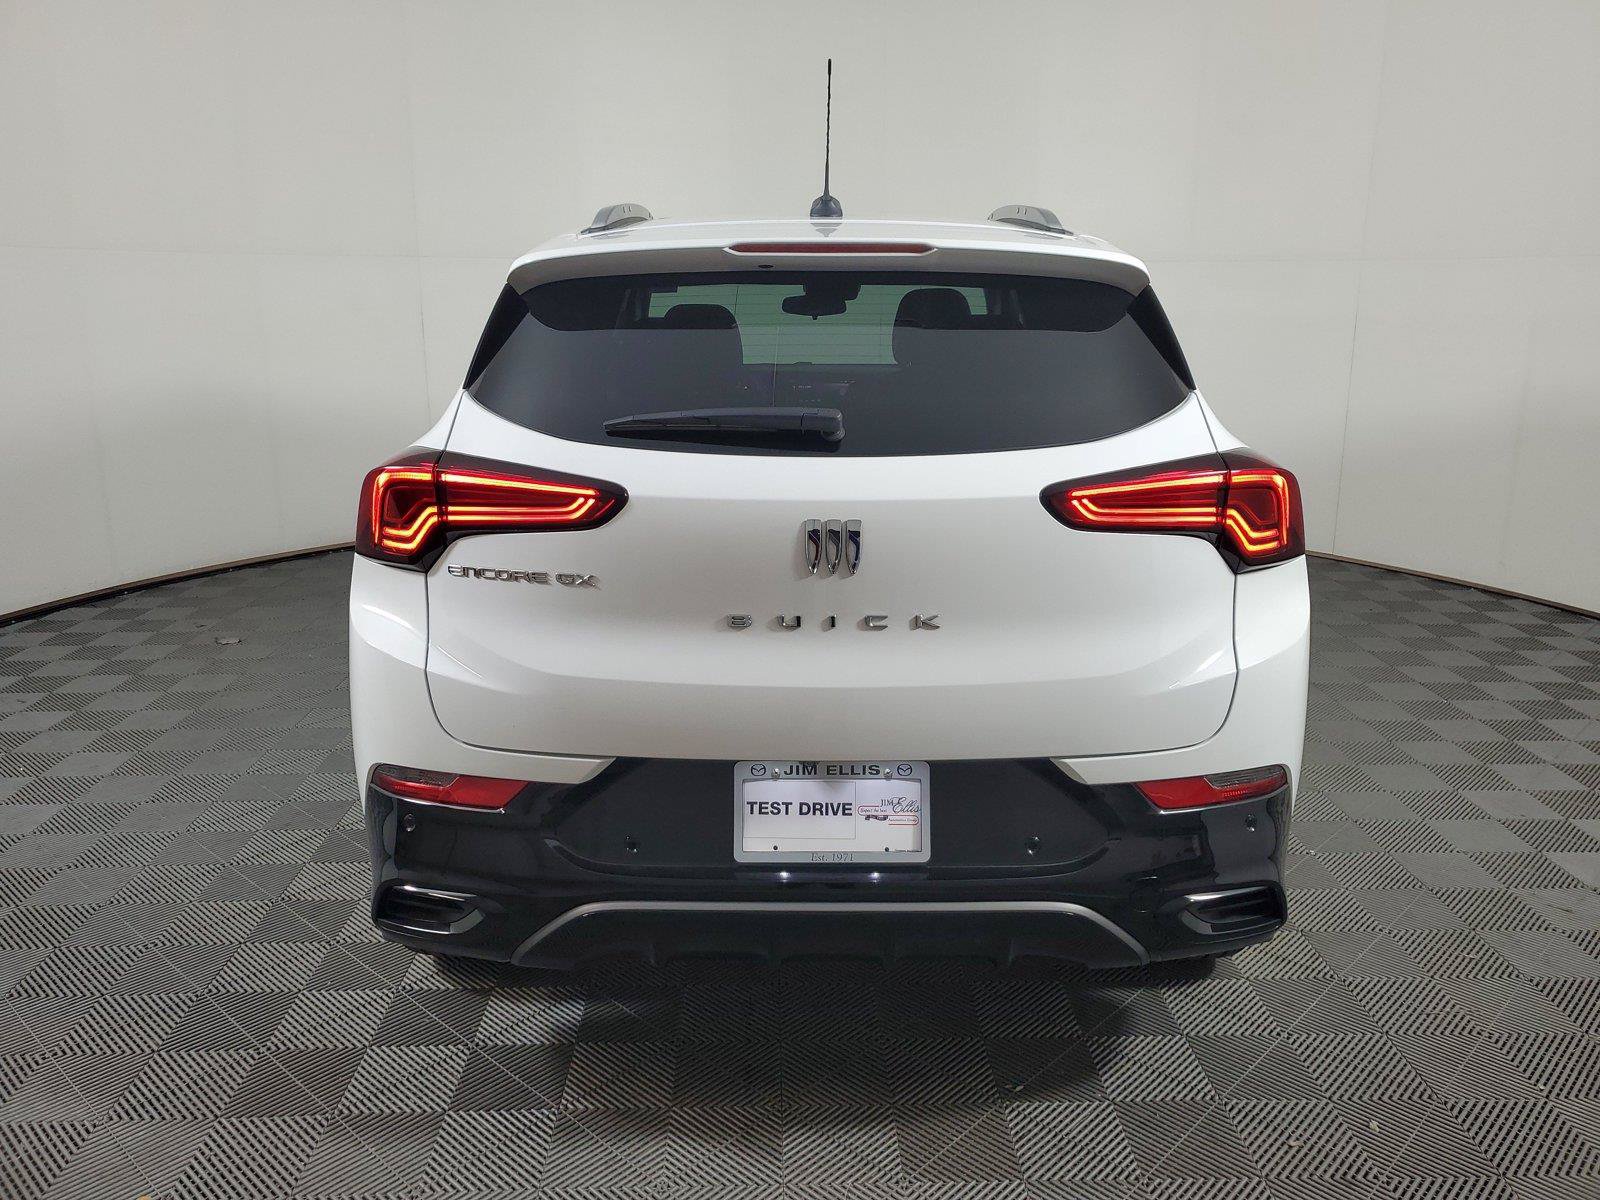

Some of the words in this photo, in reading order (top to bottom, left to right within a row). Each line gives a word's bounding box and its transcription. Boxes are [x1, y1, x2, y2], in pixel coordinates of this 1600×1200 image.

[447, 564, 550, 585] ENCORE
[555, 572, 597, 588] GX
[726, 613, 941, 630] BUICK
[783, 764, 818, 776] JIM
[826, 764, 881, 776] ELLIS
[746, 801, 793, 815] TEST
[798, 802, 853, 817] DRIVE
[880, 798, 894, 807] JIM
[893, 796, 920, 814] Ellis
[811, 853, 828, 861] Est.
[832, 853, 854, 861] 1971
